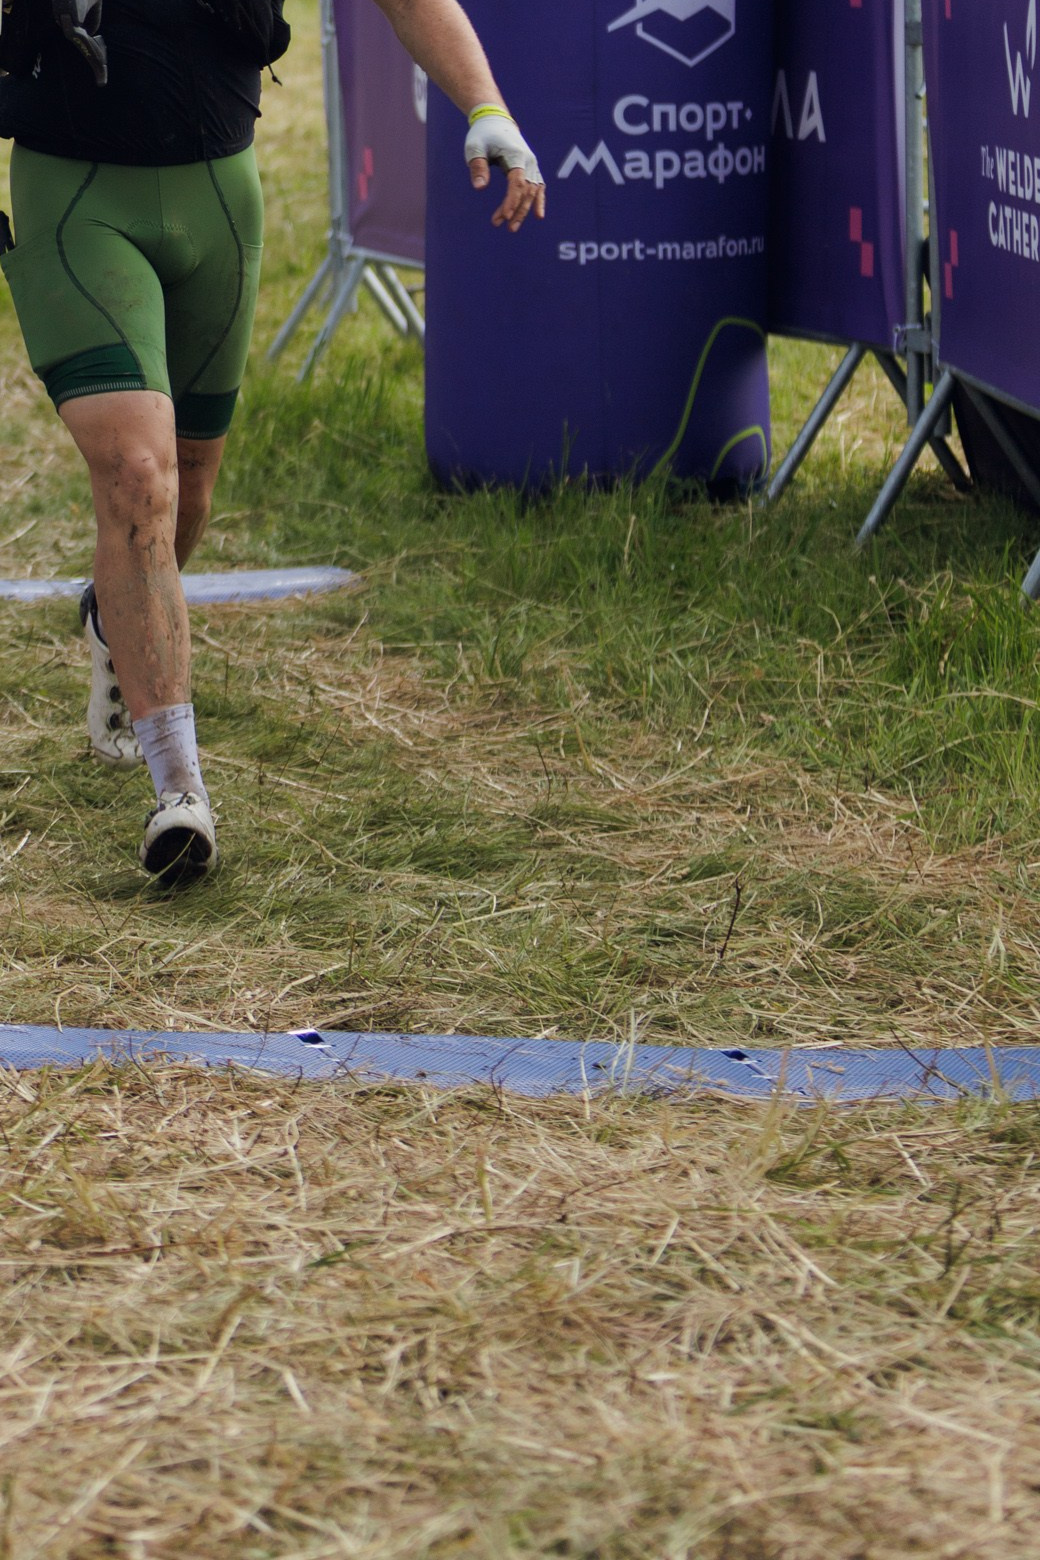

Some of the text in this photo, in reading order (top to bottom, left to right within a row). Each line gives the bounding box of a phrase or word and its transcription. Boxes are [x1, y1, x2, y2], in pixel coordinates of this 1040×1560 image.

[557, 139, 765, 190] Марафон
[980, 144, 994, 180] The
[558, 236, 764, 265] sport-marafon.ru
